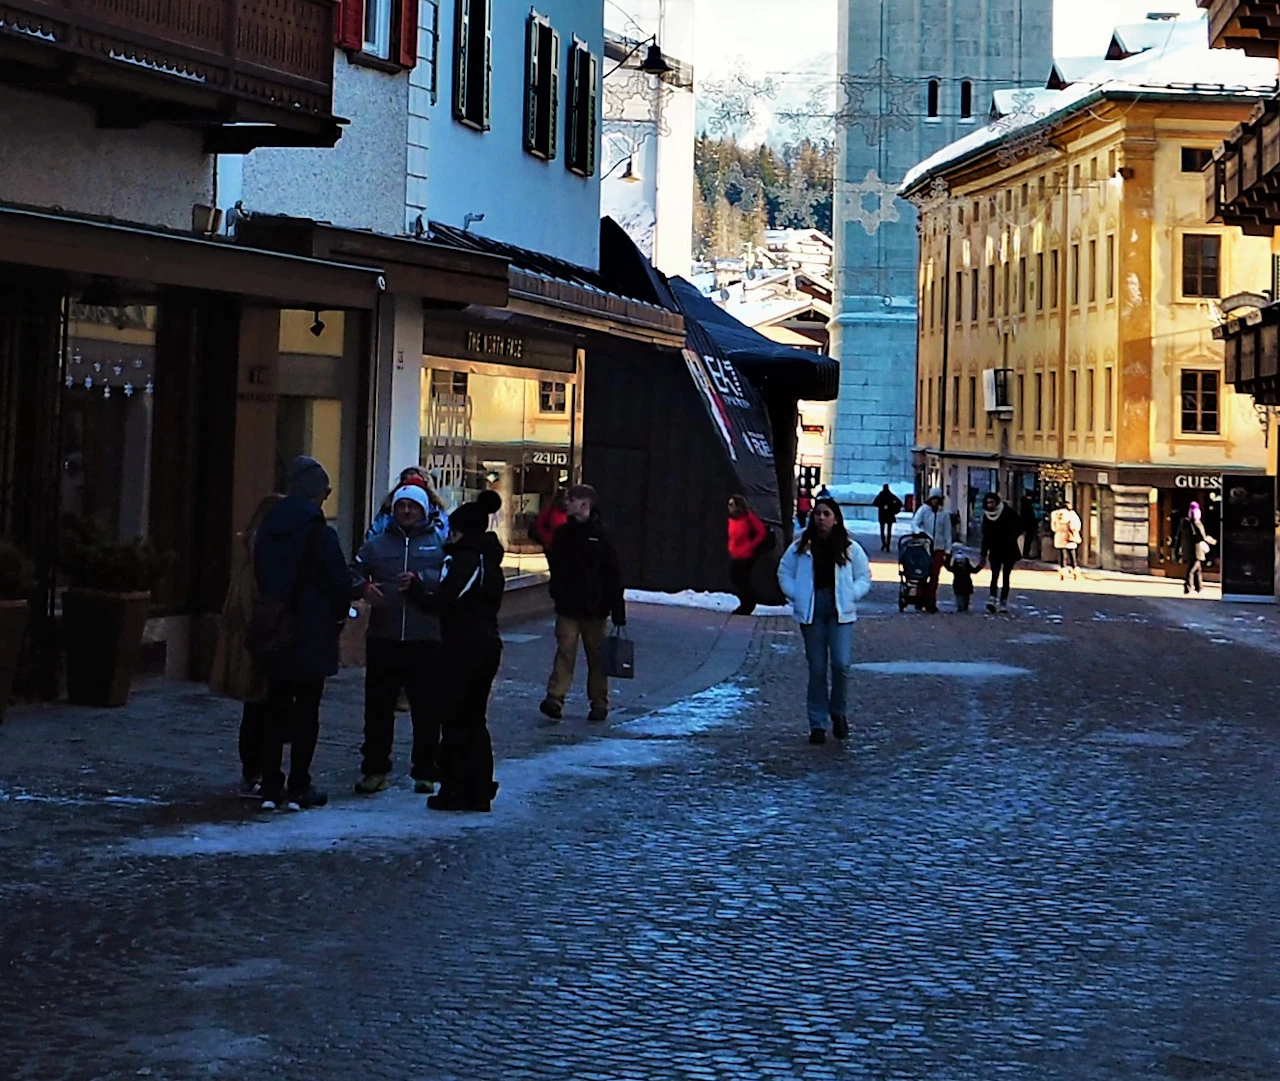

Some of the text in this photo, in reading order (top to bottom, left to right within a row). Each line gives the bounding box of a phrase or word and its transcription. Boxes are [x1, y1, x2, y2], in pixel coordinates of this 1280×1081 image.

[468, 331, 523, 359] THE NORTH FACE
[427, 391, 473, 447] NEVER
